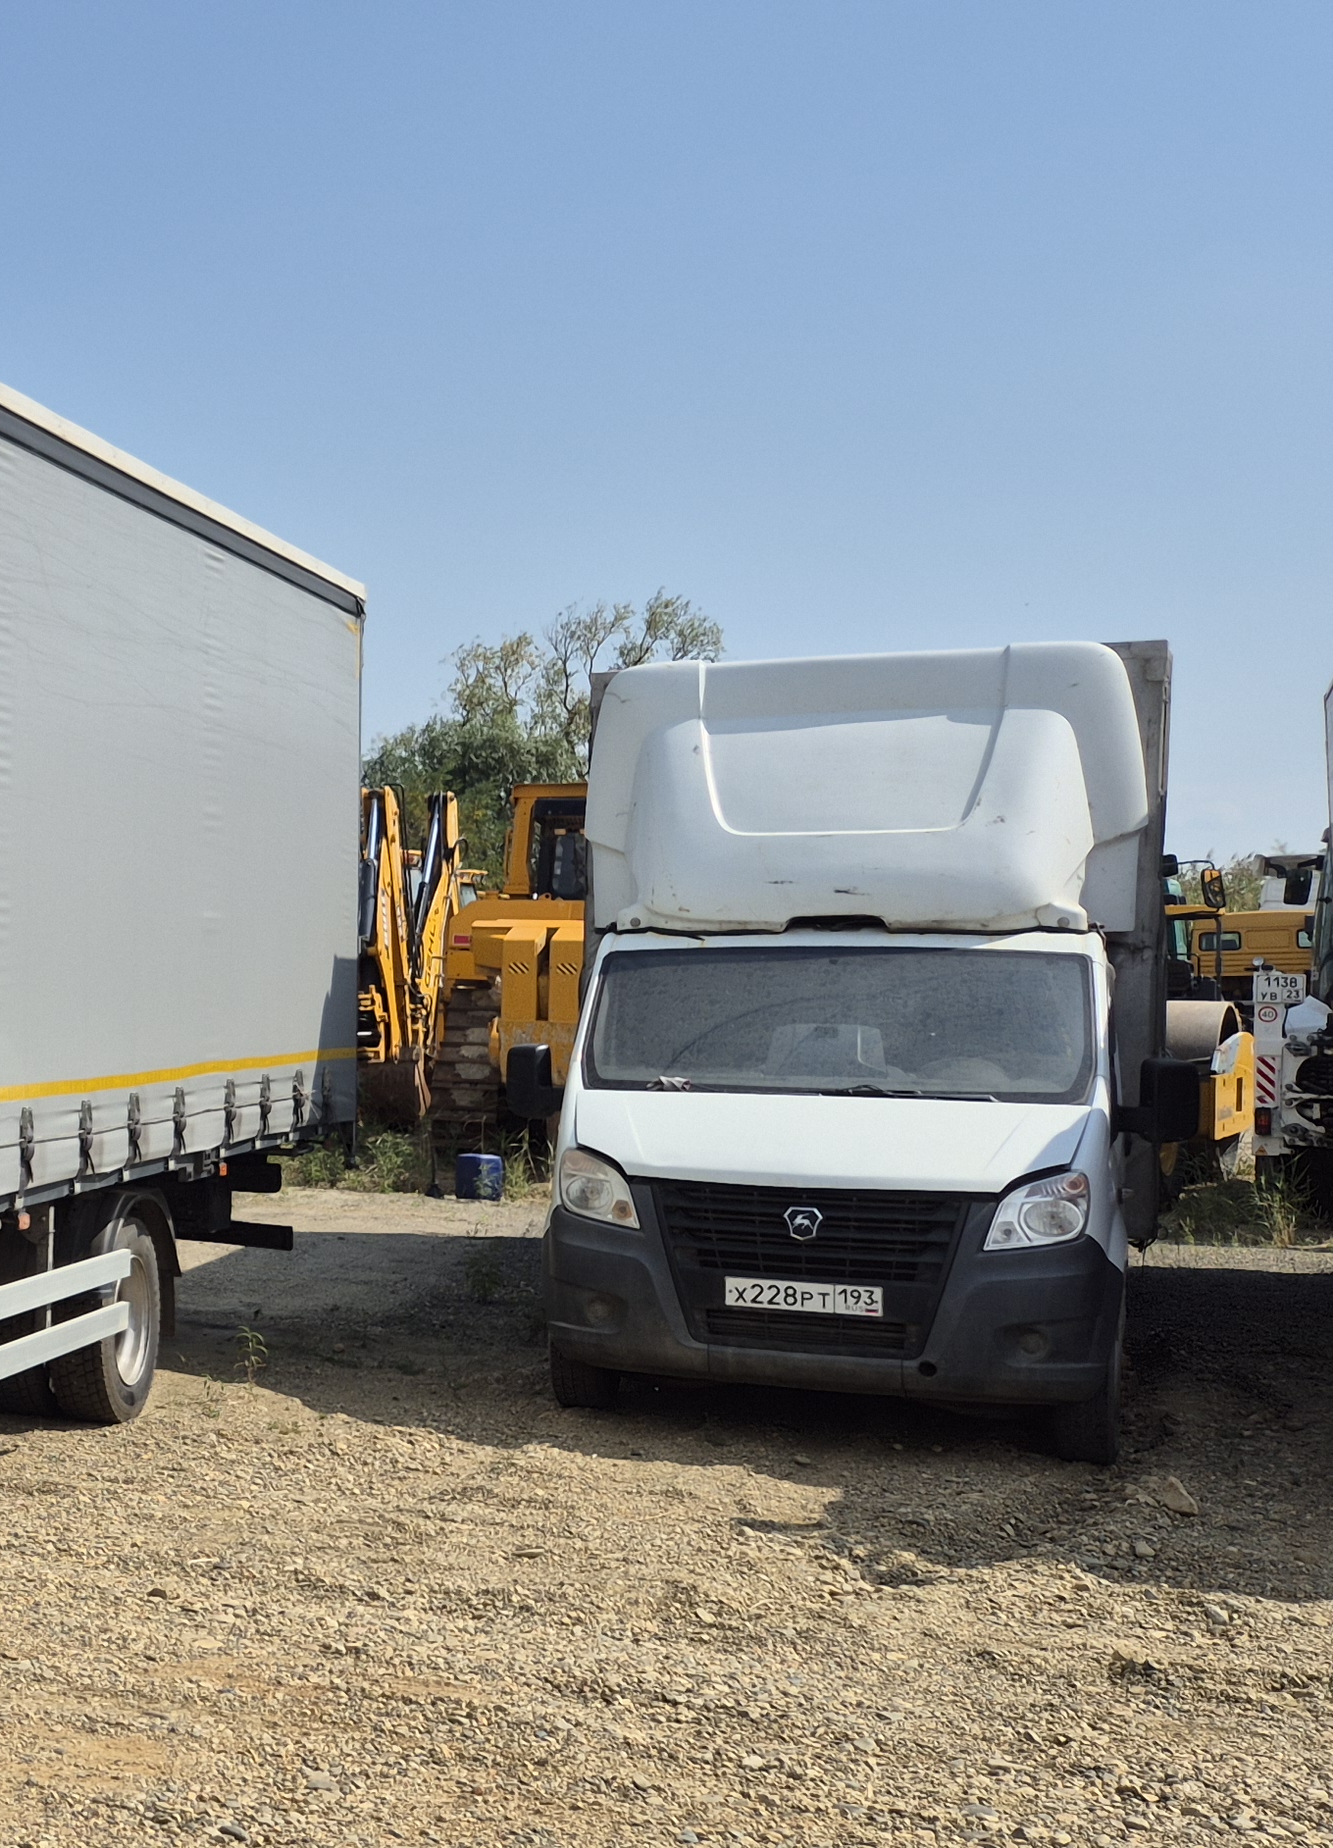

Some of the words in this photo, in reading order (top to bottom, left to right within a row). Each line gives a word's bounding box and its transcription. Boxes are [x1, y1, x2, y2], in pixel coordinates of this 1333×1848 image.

[1264, 976, 1298, 988] 1138
[1286, 989, 1300, 999] 23
[1261, 1010, 1275, 1020] 40
[734, 1283, 830, 1309] Х228РТ
[838, 1288, 875, 1306] 193
